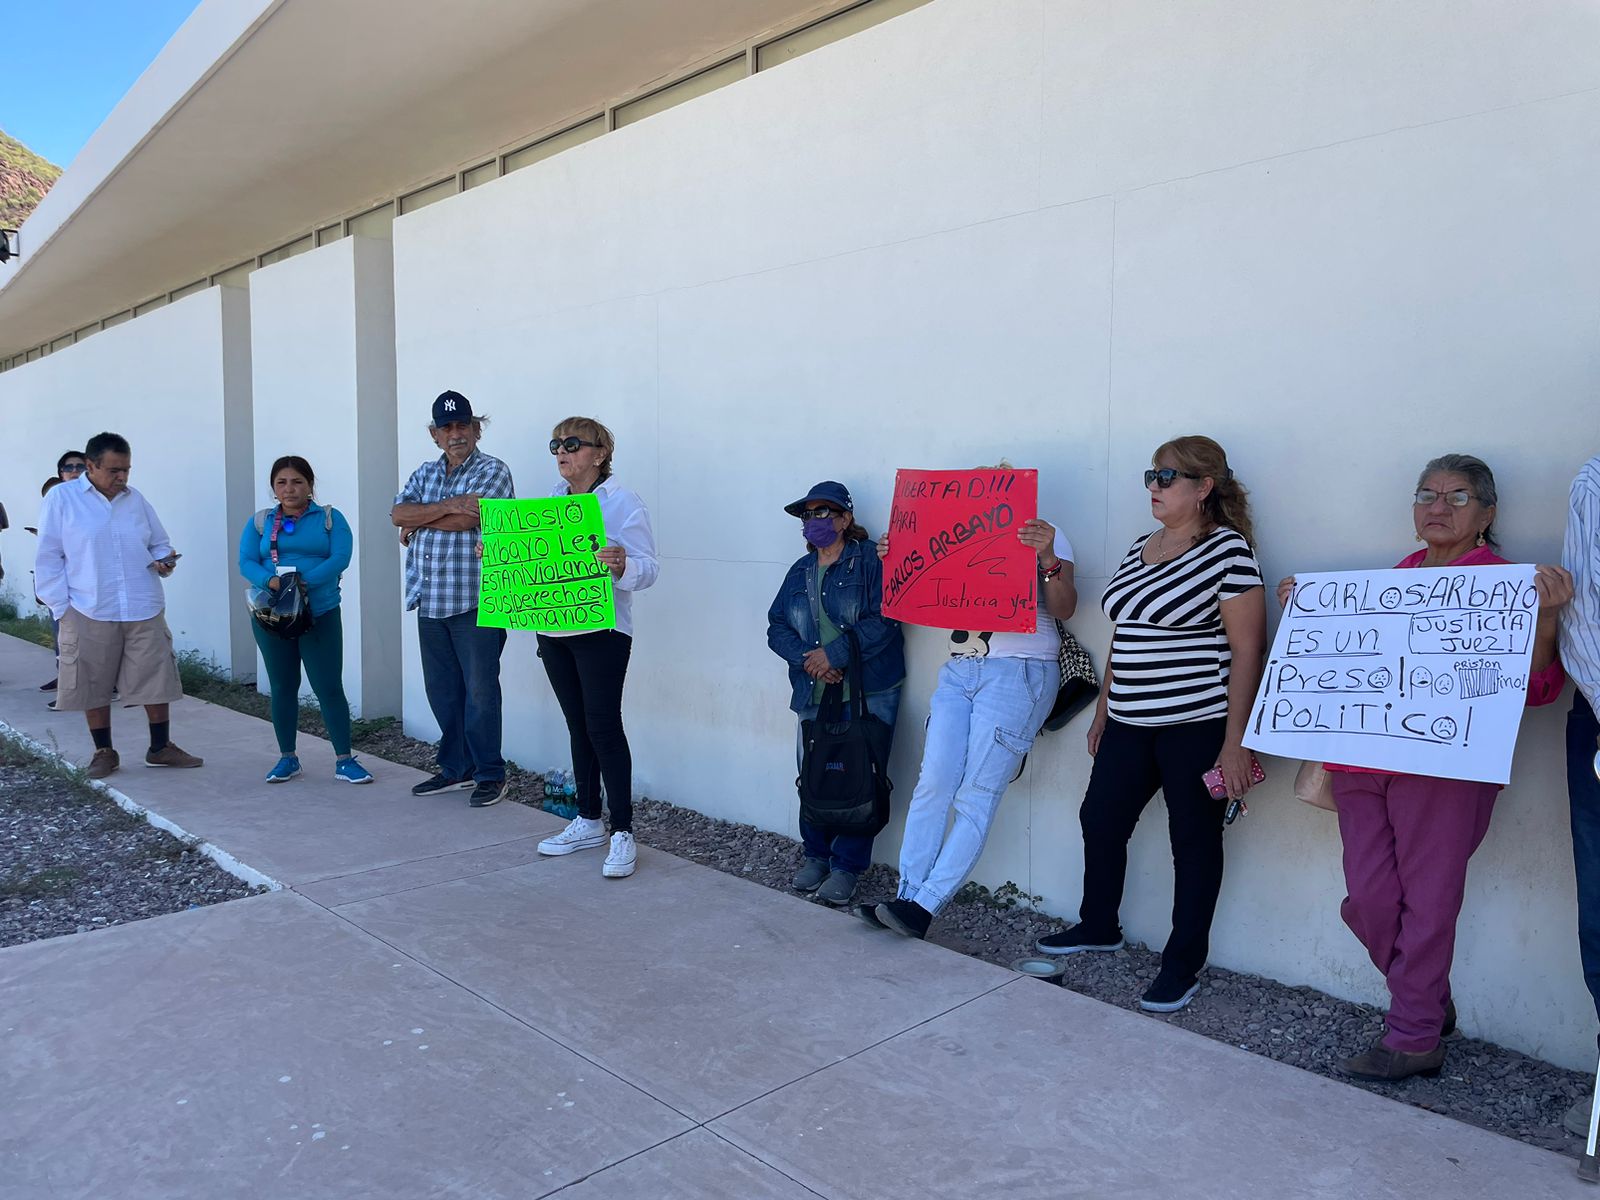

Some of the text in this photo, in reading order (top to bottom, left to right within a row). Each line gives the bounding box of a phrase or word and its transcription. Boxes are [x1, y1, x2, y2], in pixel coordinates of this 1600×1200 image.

[891, 505, 916, 533] PARA
[884, 503, 1013, 607] CARLOS ARBAYO
[917, 577, 998, 609] Justicia
[1287, 629, 1323, 656] ES
